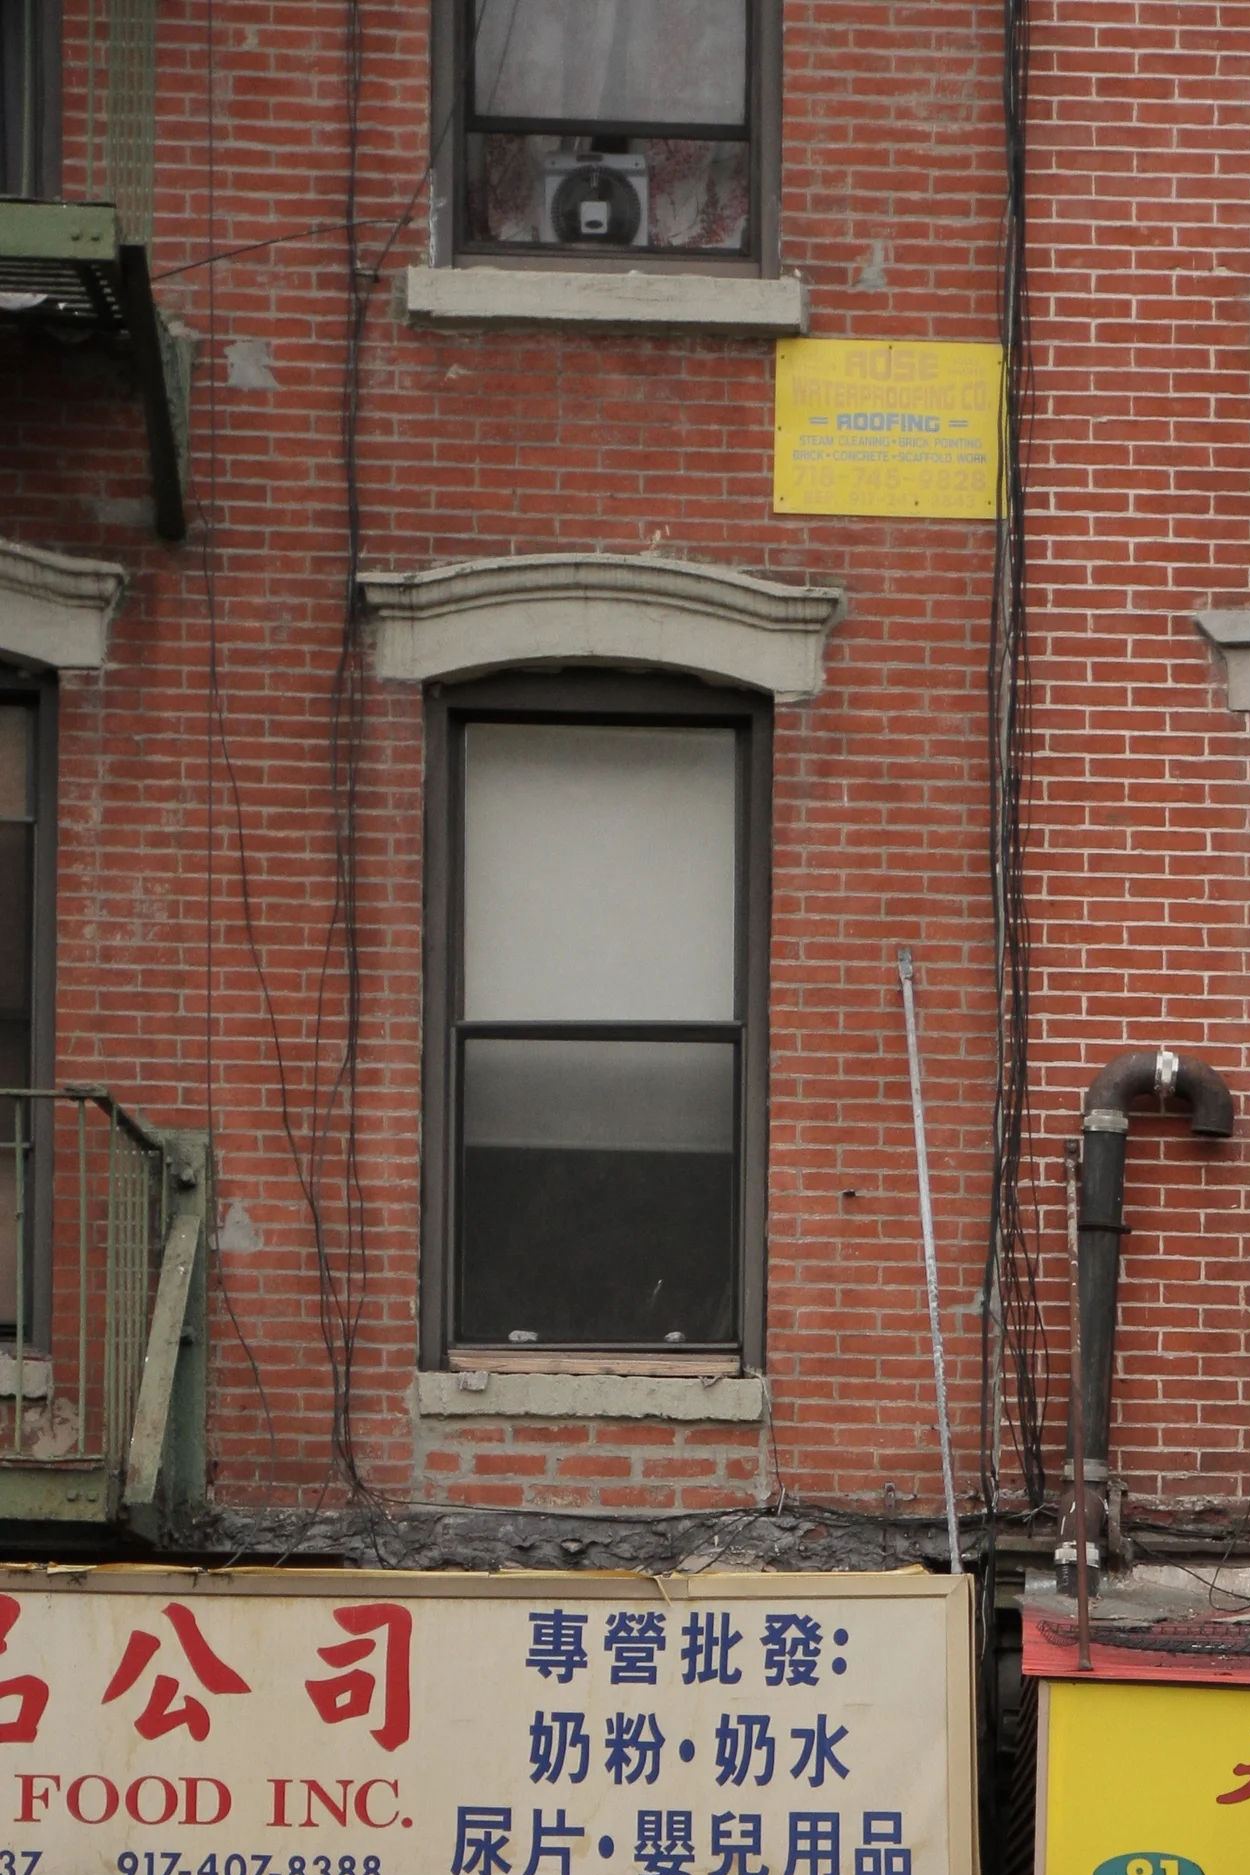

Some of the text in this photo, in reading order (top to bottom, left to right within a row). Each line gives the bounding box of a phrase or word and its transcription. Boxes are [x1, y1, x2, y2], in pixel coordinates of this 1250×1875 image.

[844, 349, 940, 381] ROSE
[792, 376, 993, 411] WATERPROOFING CO.
[836, 412, 941, 433] ROOFING
[792, 449, 987, 465] BRICK CONCRETE SCAFFOLD WORK
[799, 435, 834, 447] STEAM
[838, 436, 890, 448] CLEANING
[934, 438, 983, 450] POINTING
[792, 465, 987, 491] 718-745-9828
[525, 1608, 849, 1686] 專營批發:
[13, 1774, 413, 1829] FOOD INC.
